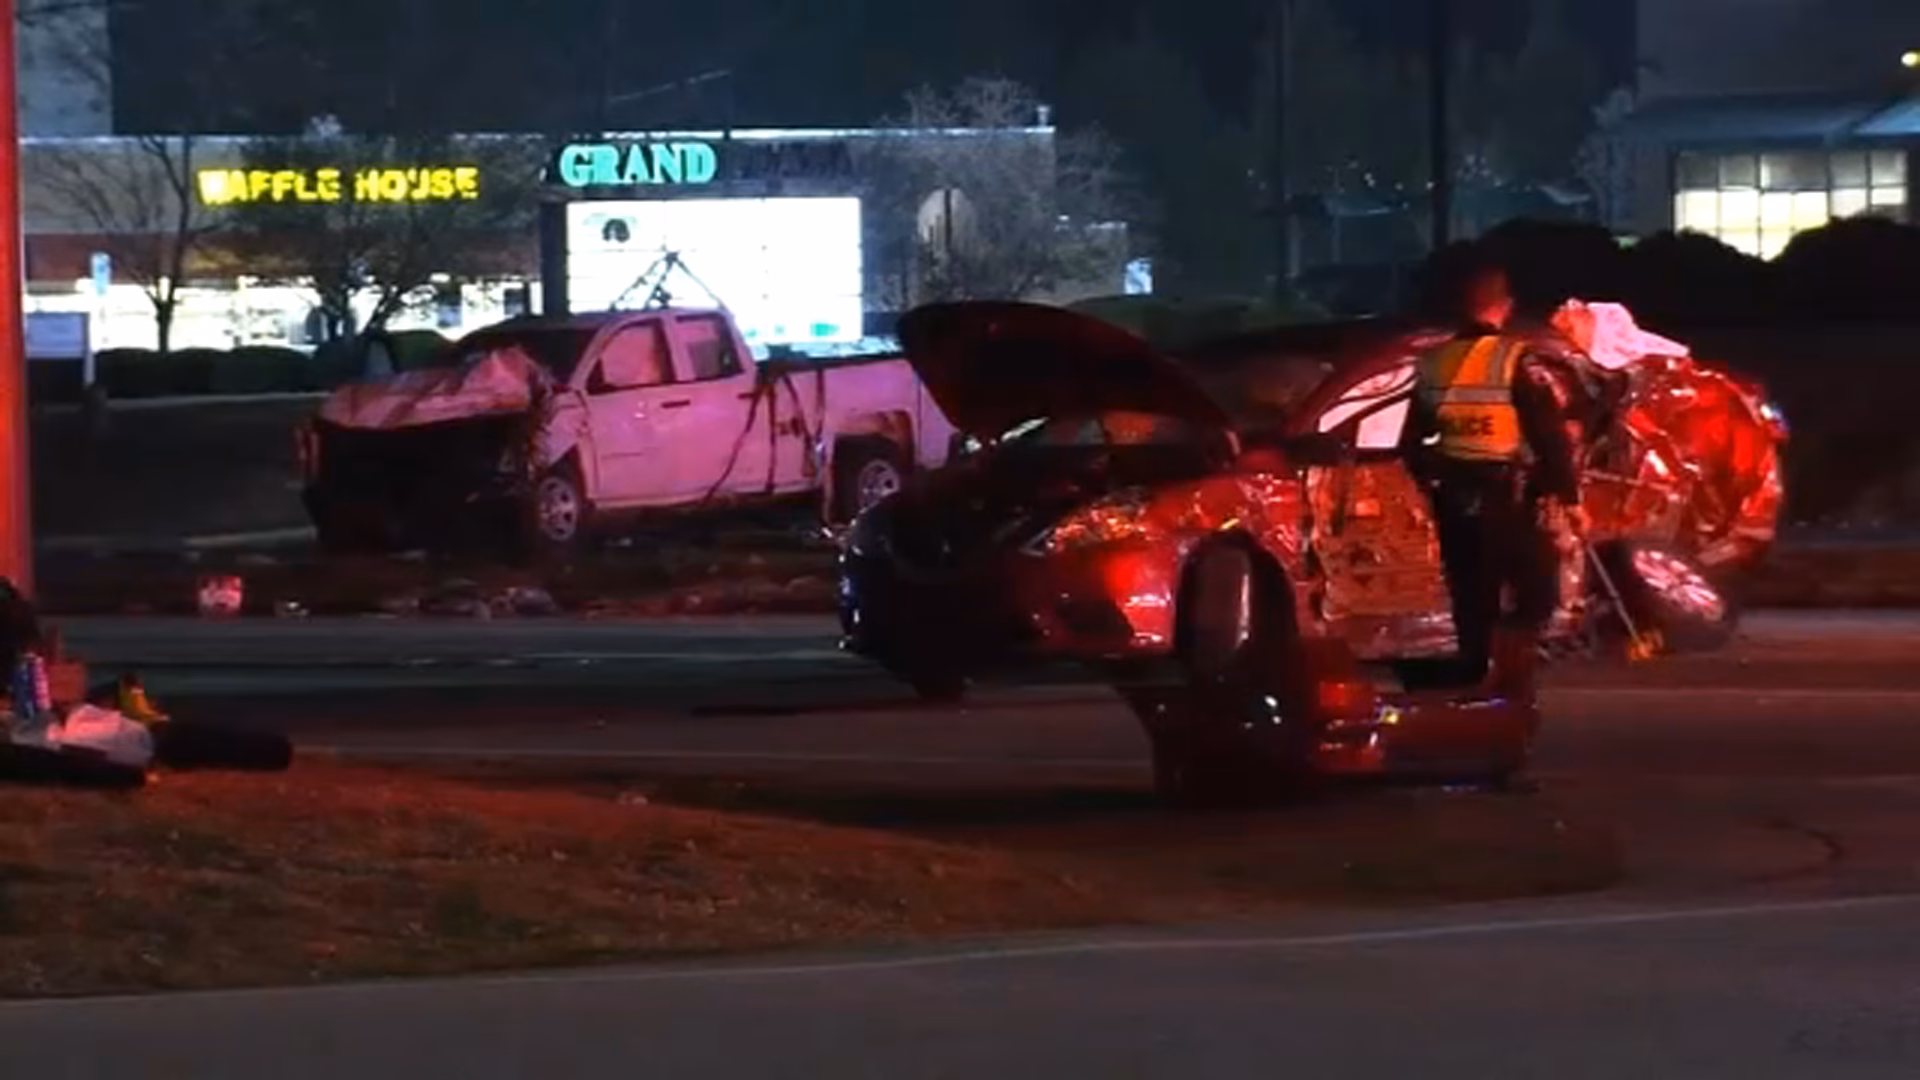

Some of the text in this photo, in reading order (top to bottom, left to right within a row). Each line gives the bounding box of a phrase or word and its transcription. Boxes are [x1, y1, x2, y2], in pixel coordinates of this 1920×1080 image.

[197, 165, 478, 206] WAFFLE HOUSE
[558, 143, 716, 187] GRAND
